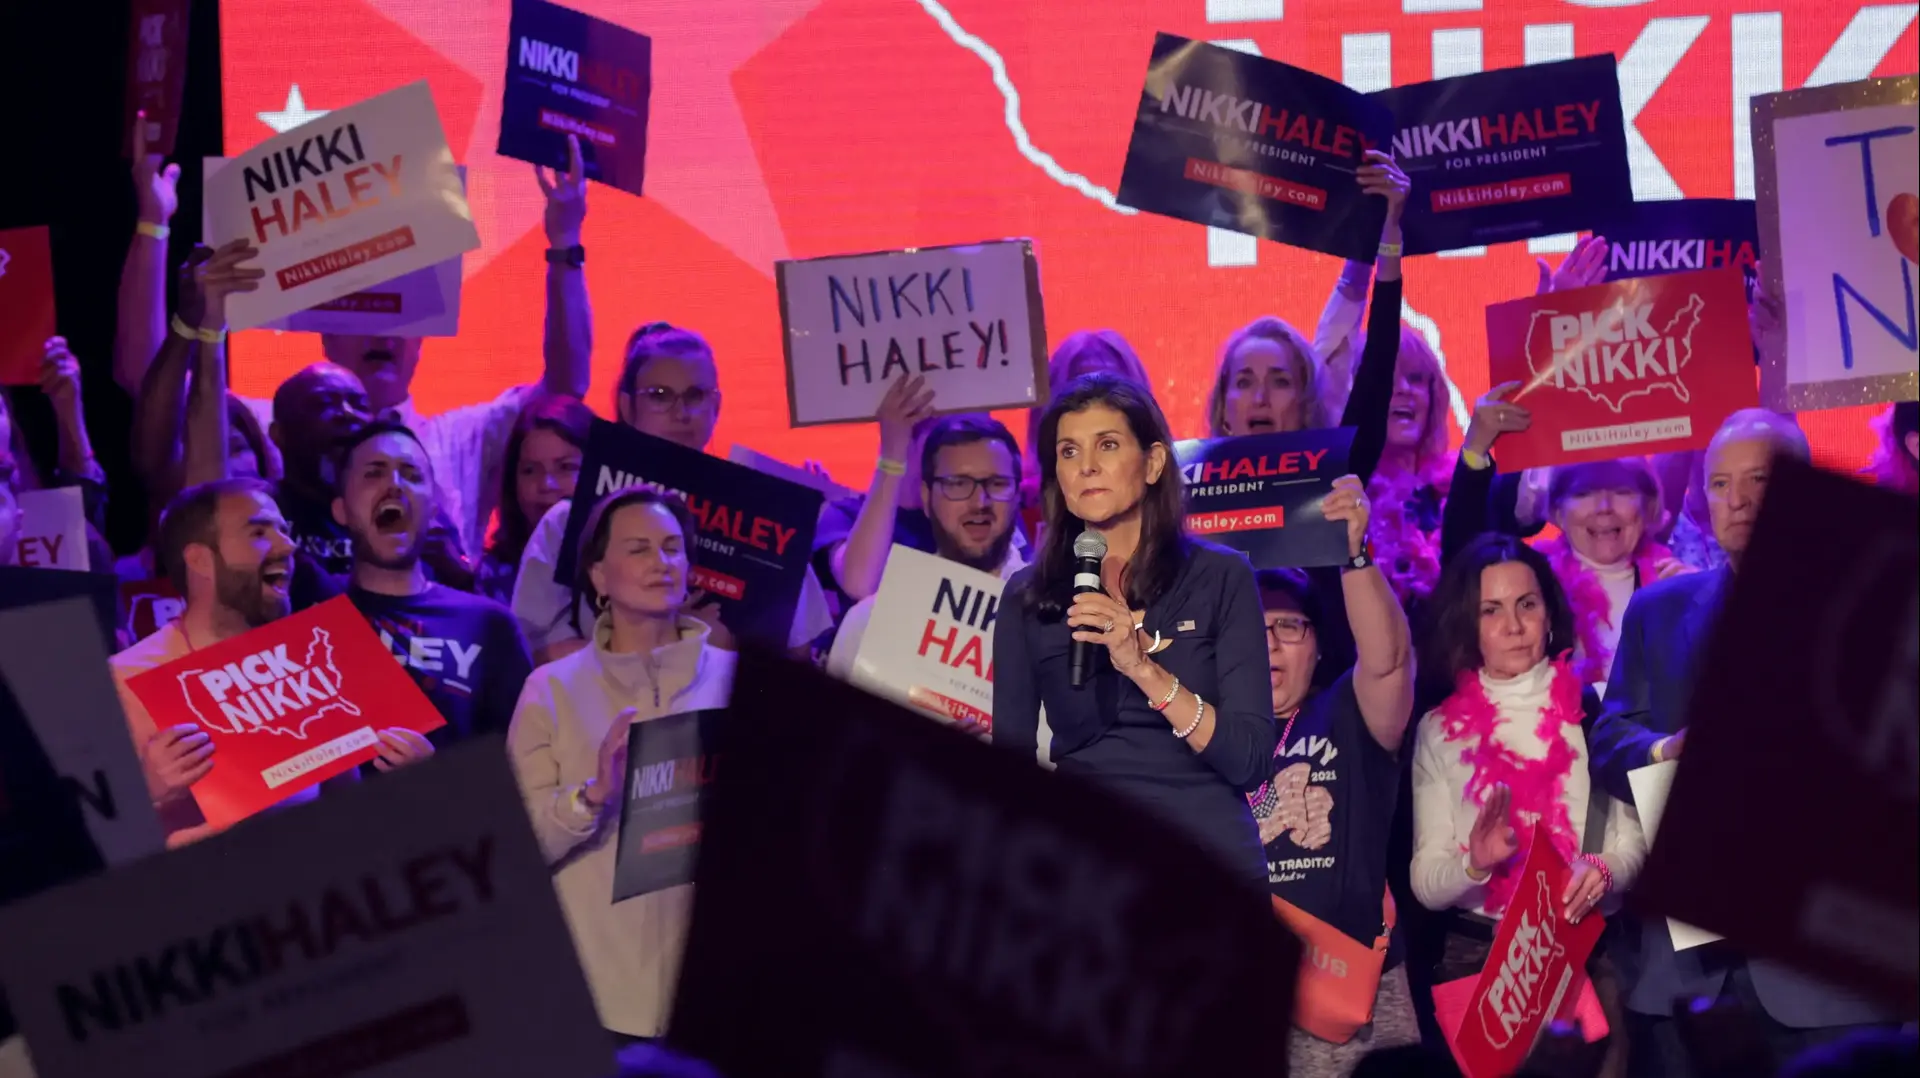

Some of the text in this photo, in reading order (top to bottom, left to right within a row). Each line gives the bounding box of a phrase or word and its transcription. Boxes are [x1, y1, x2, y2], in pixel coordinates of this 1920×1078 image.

[243, 123, 365, 203] NIKKI
[1446, 145, 1547, 170] FOR PRESIDENT
[251, 154, 403, 243] HALEY
[1439, 178, 1565, 208] NikkiHaley.com
[828, 267, 974, 333] NIKKI
[1550, 303, 1660, 350] PICK
[837, 318, 1009, 386] HALEY!
[1552, 337, 1678, 389] NIKKI
[1569, 425, 1686, 446] NikkiHaley.com
[1191, 482, 1265, 498] PRESIDENT
[199, 643, 304, 703] PICK
[219, 666, 338, 734] NIKKI
[1311, 769, 1338, 782] 2021
[1279, 856, 1336, 871] TRADITIO
[1487, 908, 1539, 1018] PICK
[1500, 919, 1554, 1041] NIKKI
